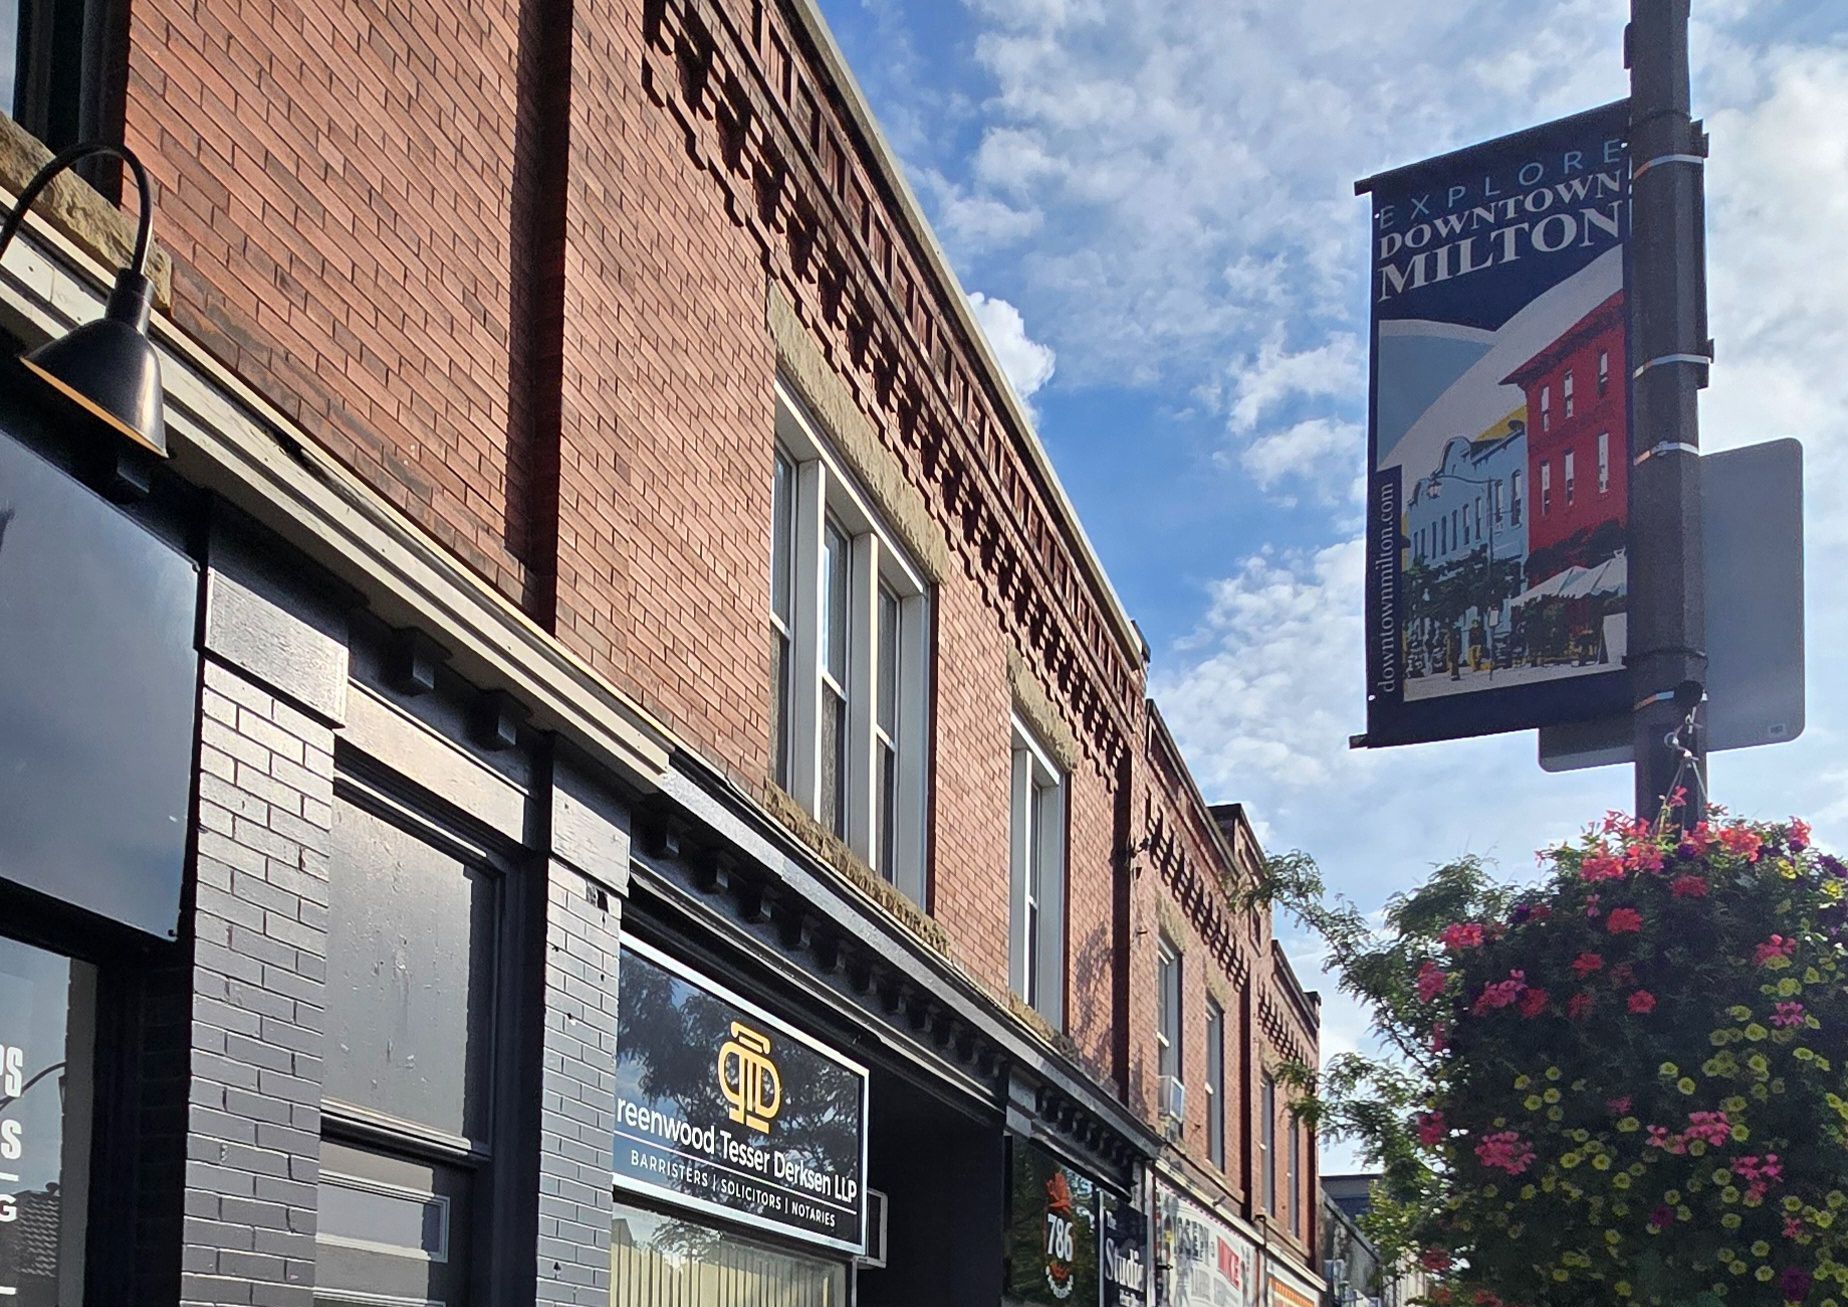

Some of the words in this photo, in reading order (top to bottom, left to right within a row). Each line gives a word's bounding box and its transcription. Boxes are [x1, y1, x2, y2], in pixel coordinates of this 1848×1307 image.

[1379, 138, 1621, 229] EXPLORE
[1379, 169, 1622, 262] DOWNTOWN
[1378, 198, 1621, 303] MILTON
[1377, 481, 1395, 694] downtownmilton.com
[616, 1097, 716, 1156] reenwood
[719, 1130, 770, 1174] Tesser
[773, 1155, 831, 1196] Derksen
[834, 1173, 858, 1203] LLP
[630, 1149, 708, 1188] BARRISTERS
[721, 1177, 782, 1211] SOLICITORS
[791, 1201, 836, 1228] NOTARIES
[1047, 1212, 1073, 1262] 786
